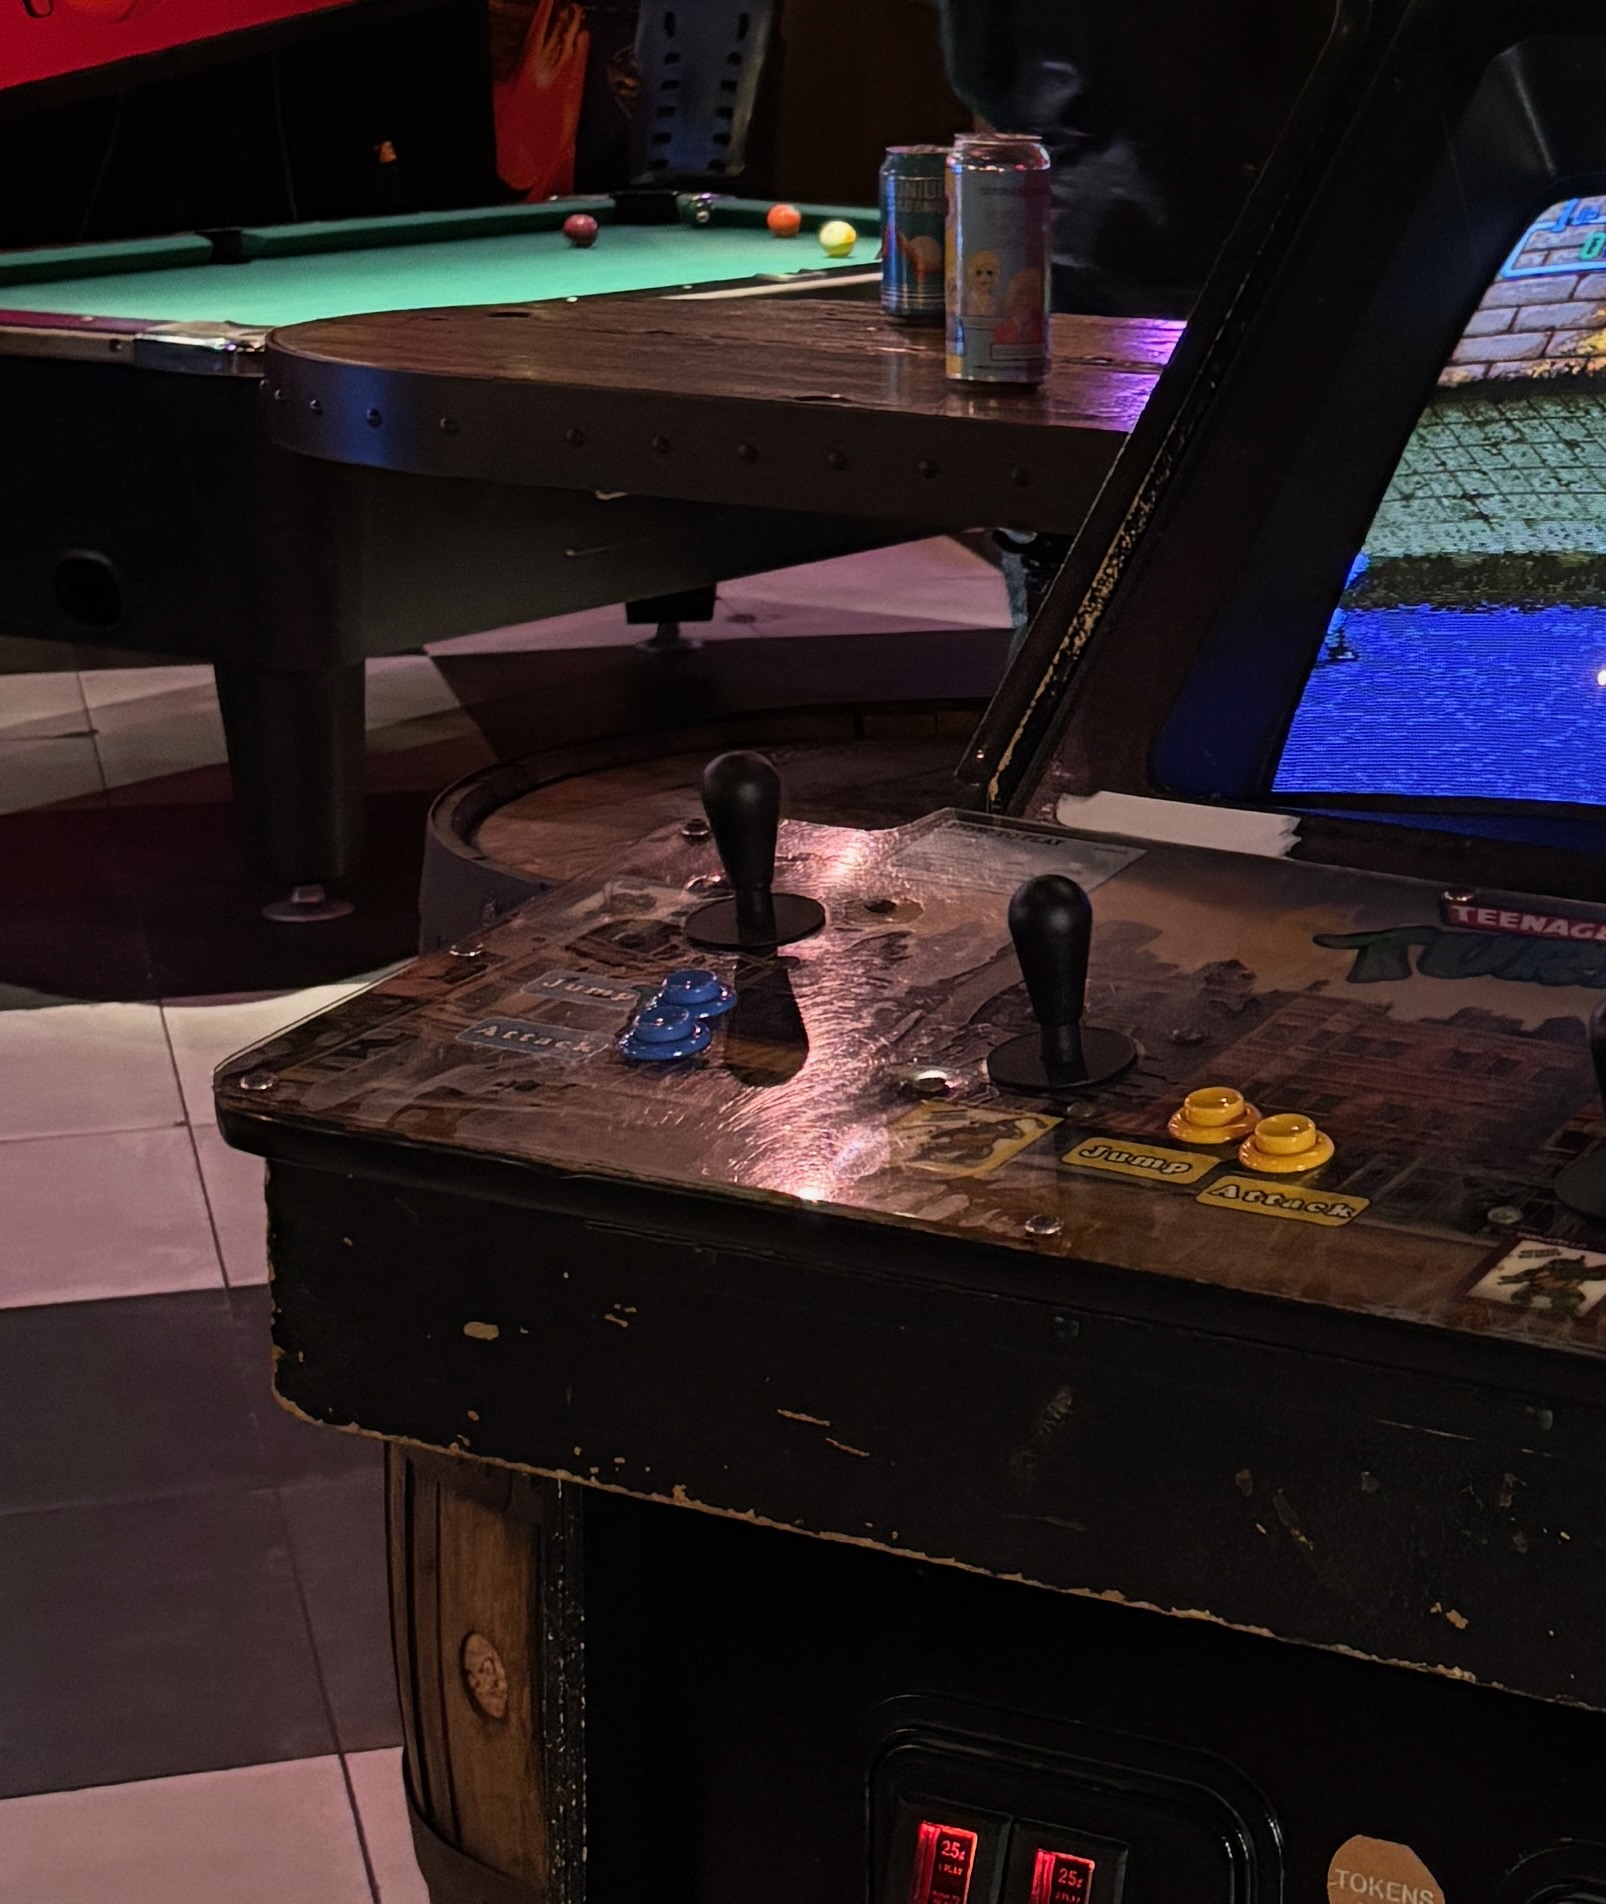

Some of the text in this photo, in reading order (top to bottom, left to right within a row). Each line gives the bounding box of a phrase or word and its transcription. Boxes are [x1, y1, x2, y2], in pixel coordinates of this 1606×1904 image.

[541, 977, 637, 1003] Jump
[475, 1024, 593, 1053] Attack
[1080, 1145, 1193, 1175] Jump
[1208, 1183, 1354, 1219] Attack
